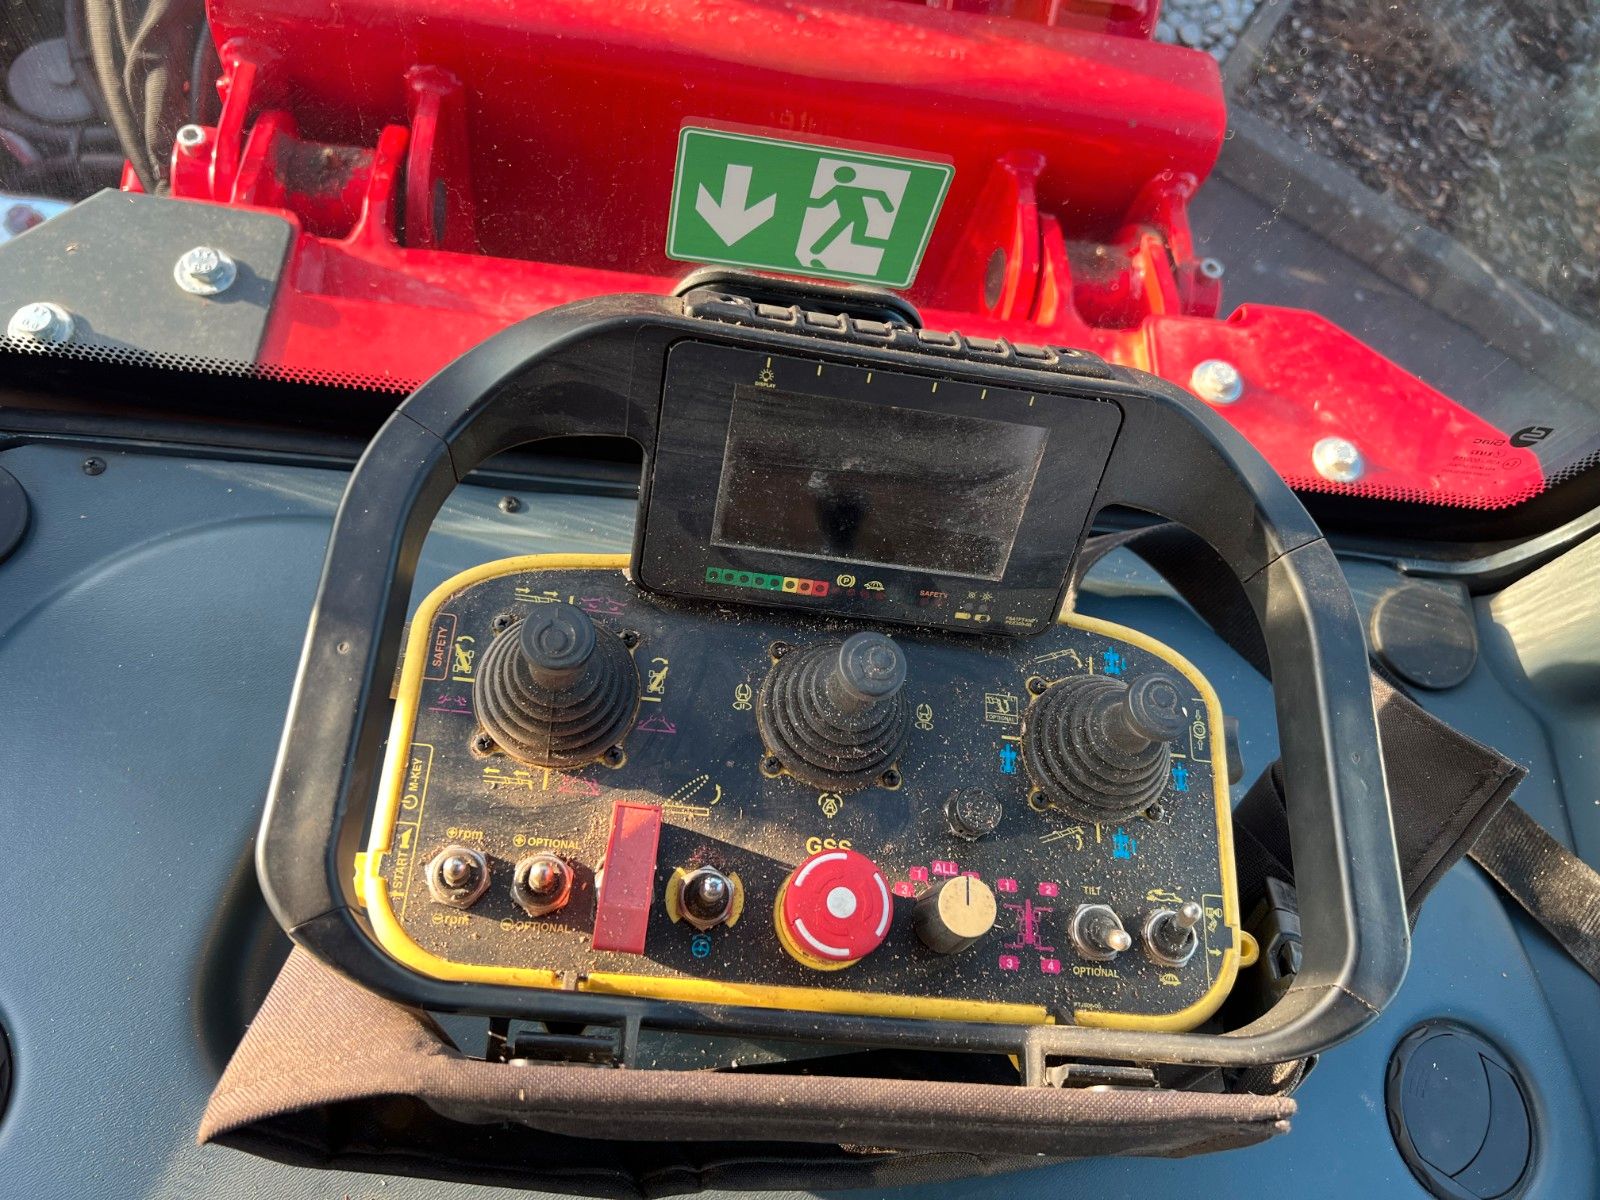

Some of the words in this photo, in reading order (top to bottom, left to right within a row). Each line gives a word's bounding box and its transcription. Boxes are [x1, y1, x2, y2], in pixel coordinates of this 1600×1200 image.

[920, 589, 949, 599] SAFETY
[432, 627, 448, 667] SAFETY
[408, 757, 423, 792] M-KEY
[458, 829, 484, 841] rpm
[527, 836, 581, 850] OPTIONAL
[393, 851, 408, 888] START
[934, 862, 958, 875] ALL
[1082, 885, 1102, 896] TILT
[516, 920, 572, 933] OPTIONAL
[1072, 965, 1120, 979] OPTIONAL
